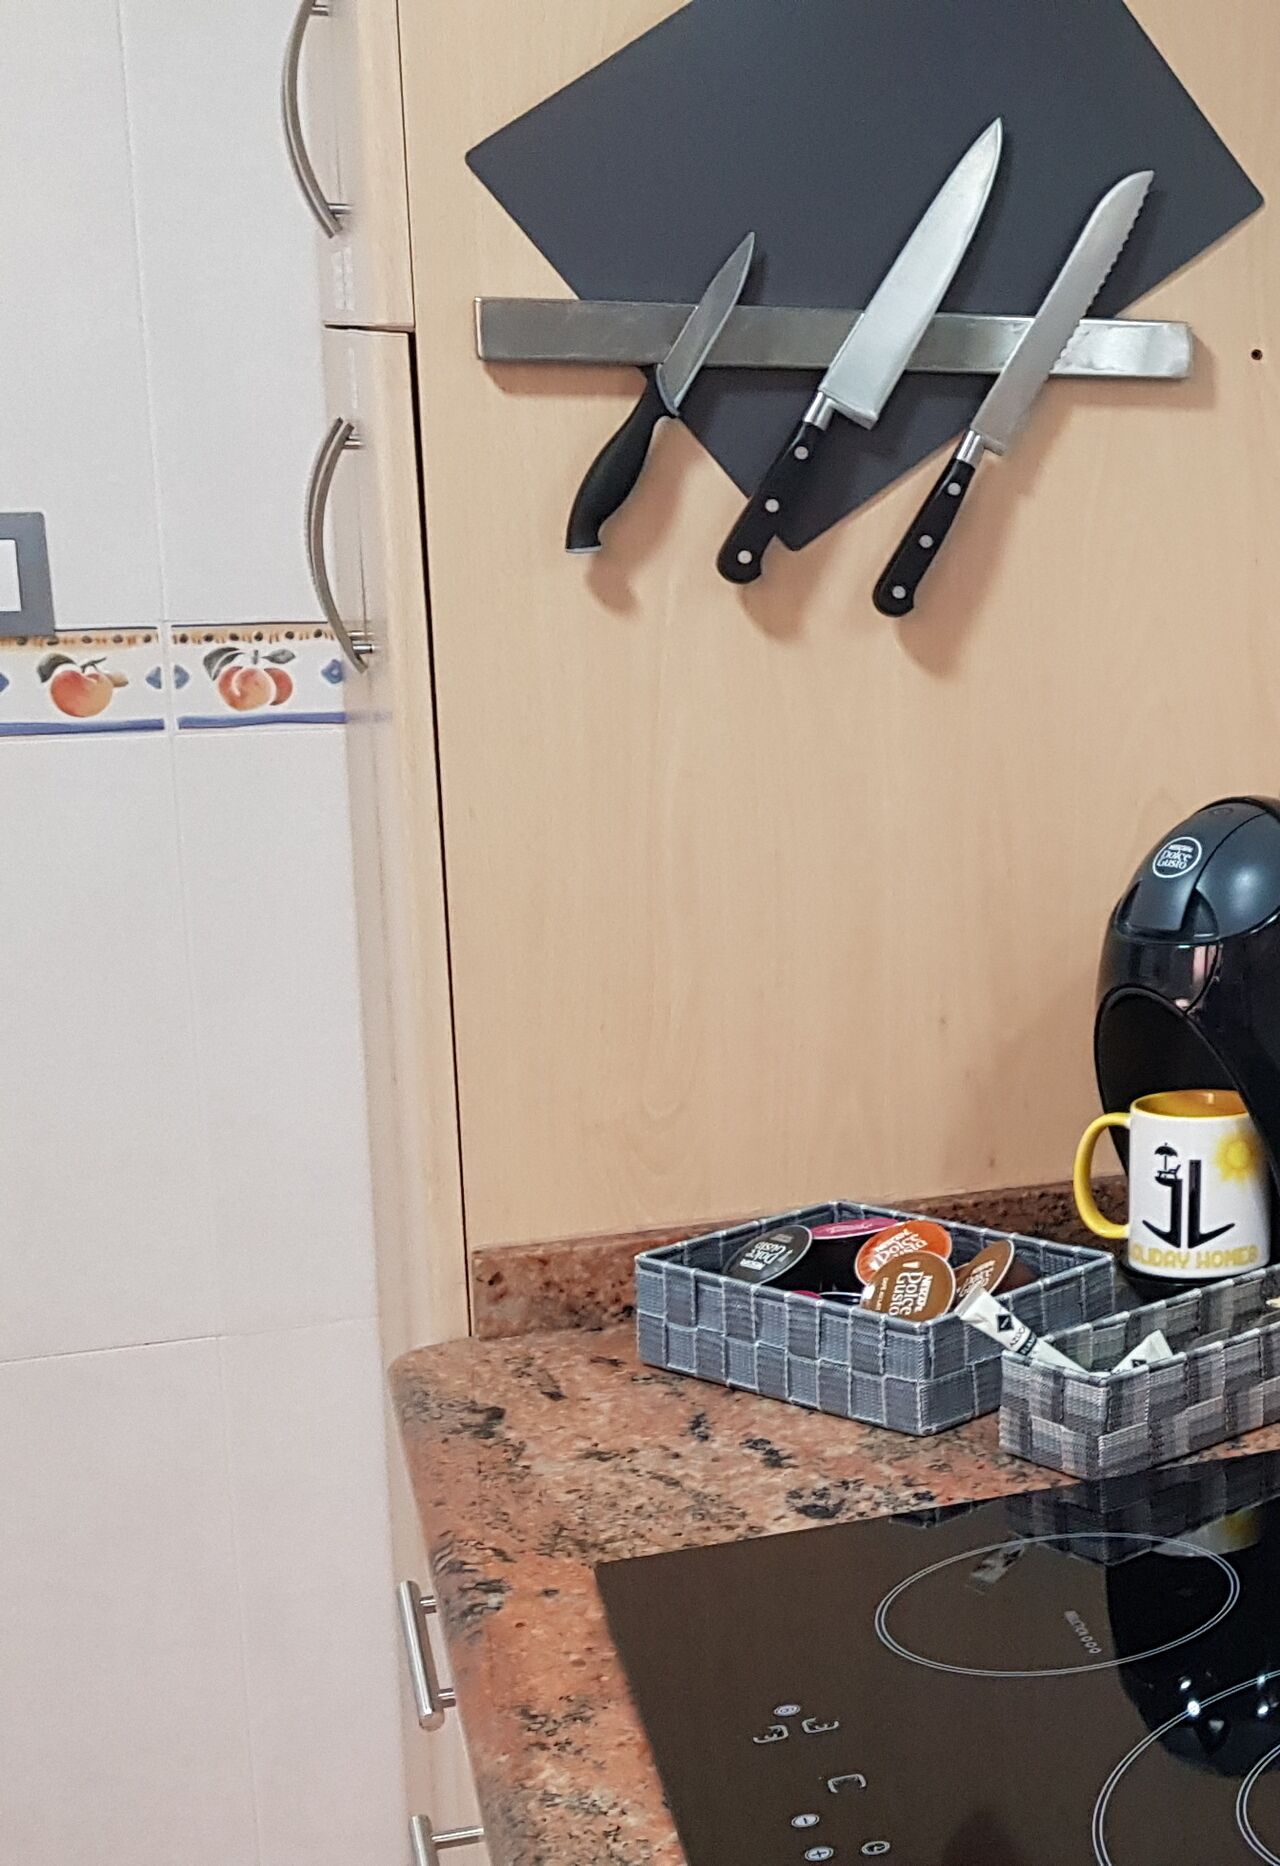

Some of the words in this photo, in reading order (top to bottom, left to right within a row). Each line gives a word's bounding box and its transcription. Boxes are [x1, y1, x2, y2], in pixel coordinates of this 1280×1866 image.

[1130, 1243, 1190, 1268] OLIDAY
[888, 1272, 911, 1316] Gusto
[900, 1271, 925, 1315] Dolce
